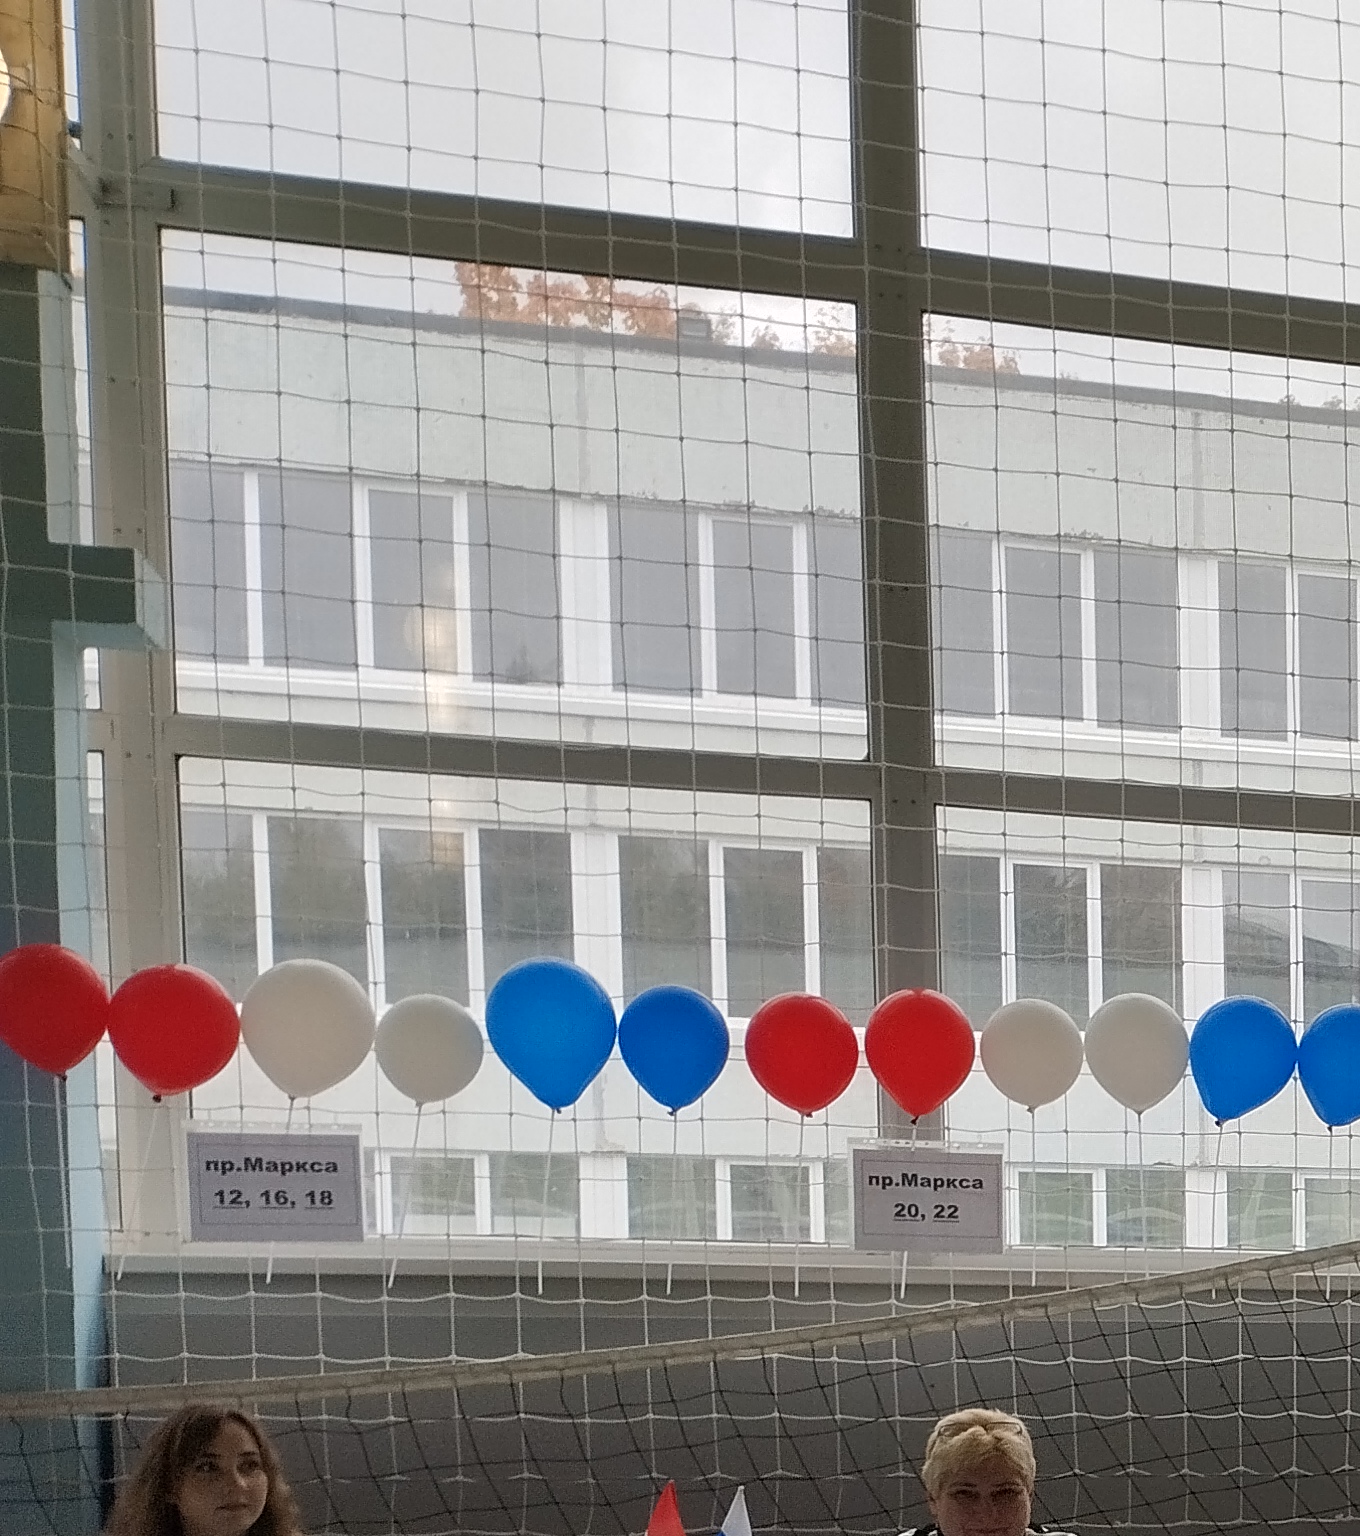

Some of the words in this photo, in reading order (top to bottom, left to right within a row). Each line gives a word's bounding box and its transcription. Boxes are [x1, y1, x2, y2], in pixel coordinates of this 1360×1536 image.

[205, 1156, 339, 1177] пр.Маркса
[868, 1172, 984, 1192] пр.Маркса
[214, 1189, 251, 1209] 12,
[260, 1190, 296, 1209] 16,
[304, 1190, 334, 1209] 18
[893, 1202, 926, 1221] 20,
[932, 1204, 960, 1222] 22
